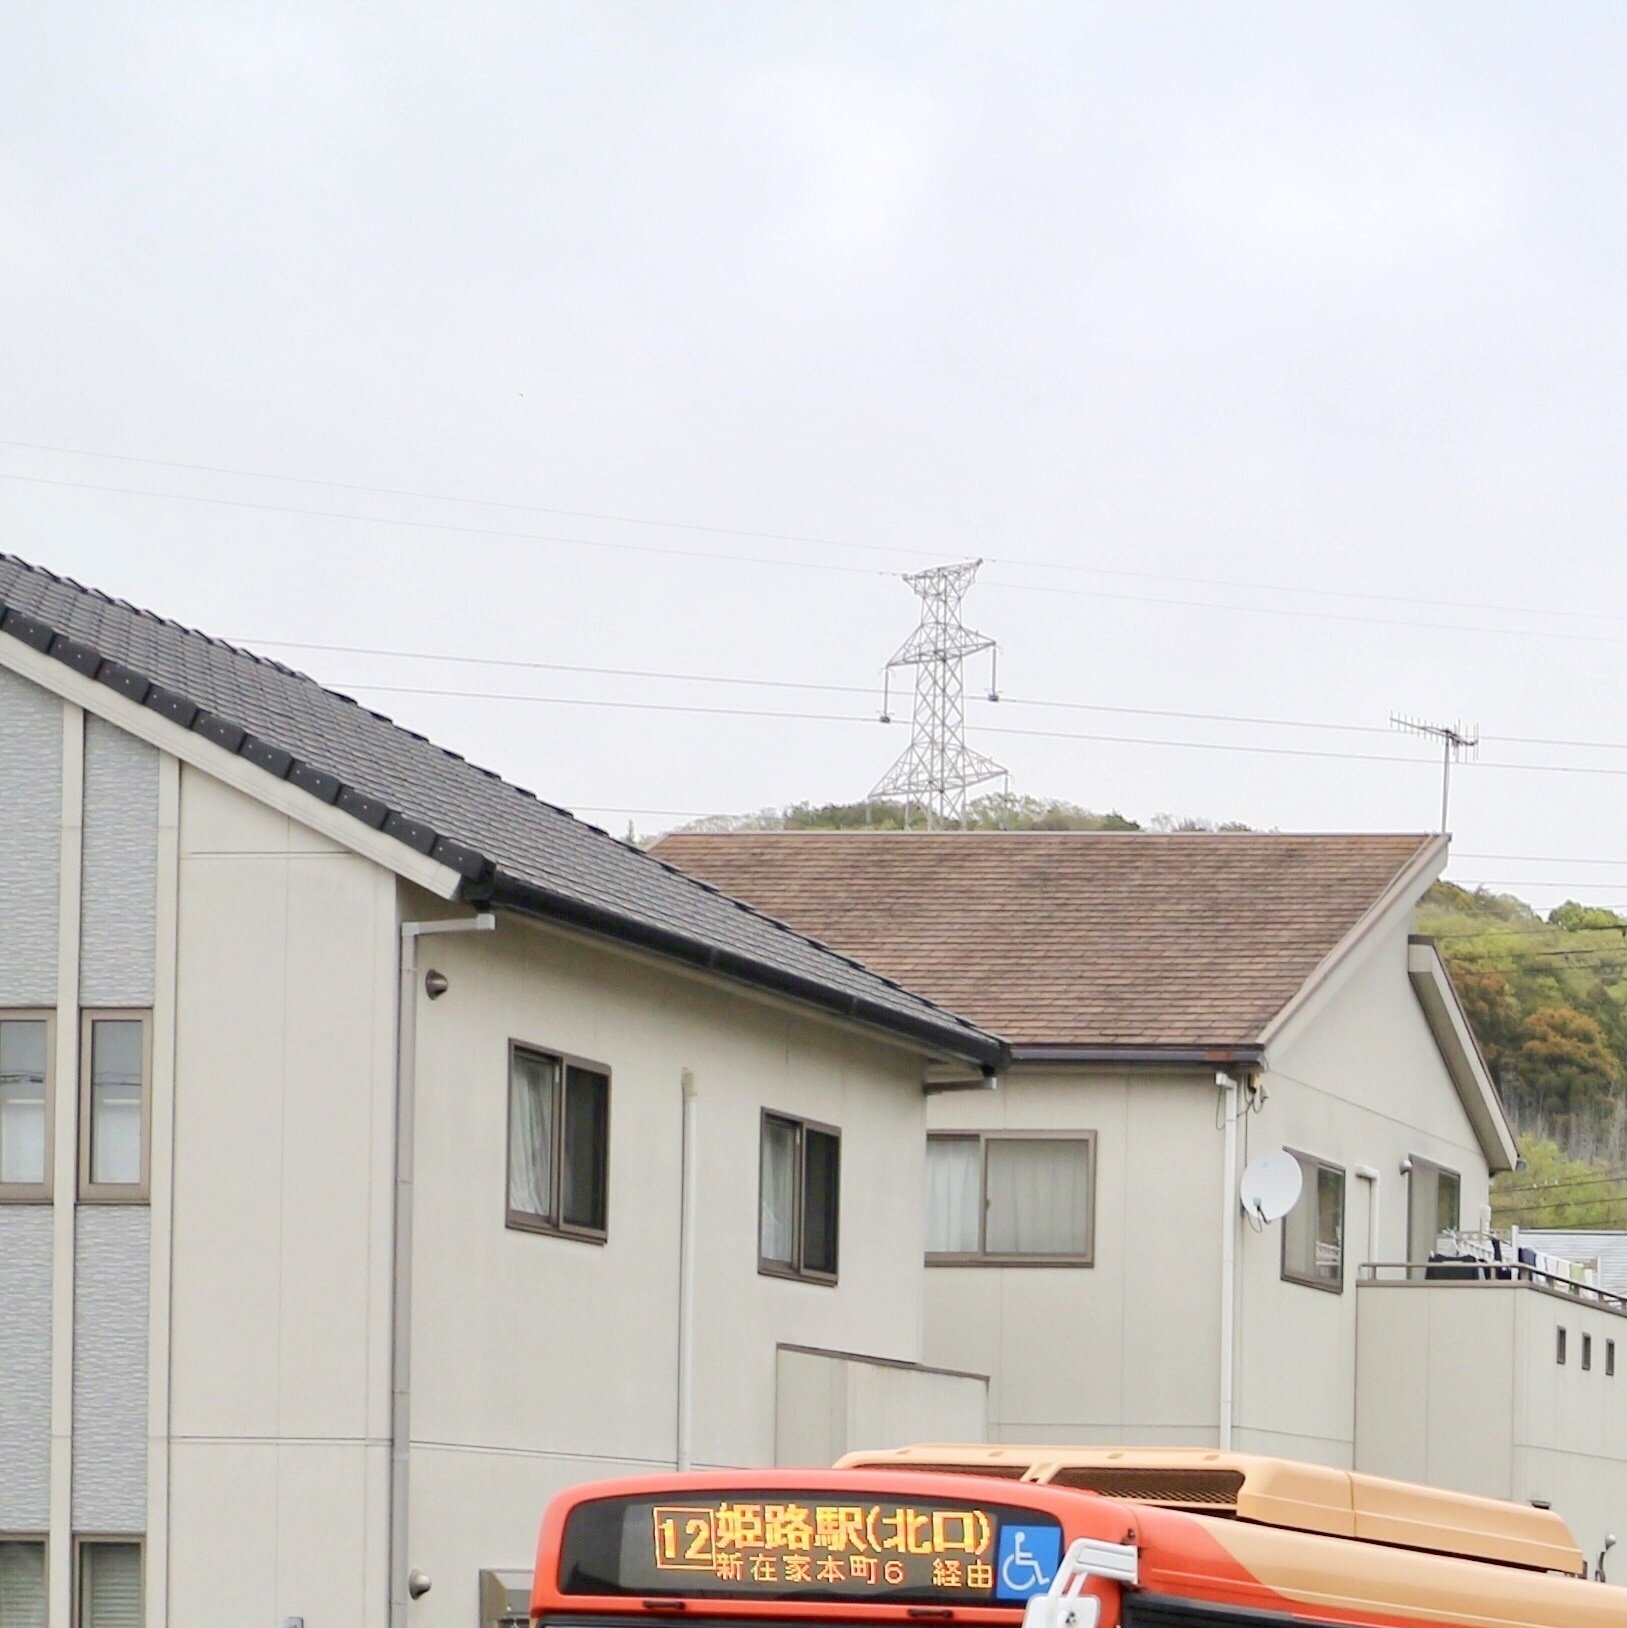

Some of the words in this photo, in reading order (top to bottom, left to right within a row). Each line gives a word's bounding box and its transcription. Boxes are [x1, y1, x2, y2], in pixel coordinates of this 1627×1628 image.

[659, 1518, 712, 1559] 12
[716, 1502, 991, 1555] 姫路駅(北口)
[716, 1552, 904, 1584] 新在家本町6
[932, 1558, 993, 1589] 経由
